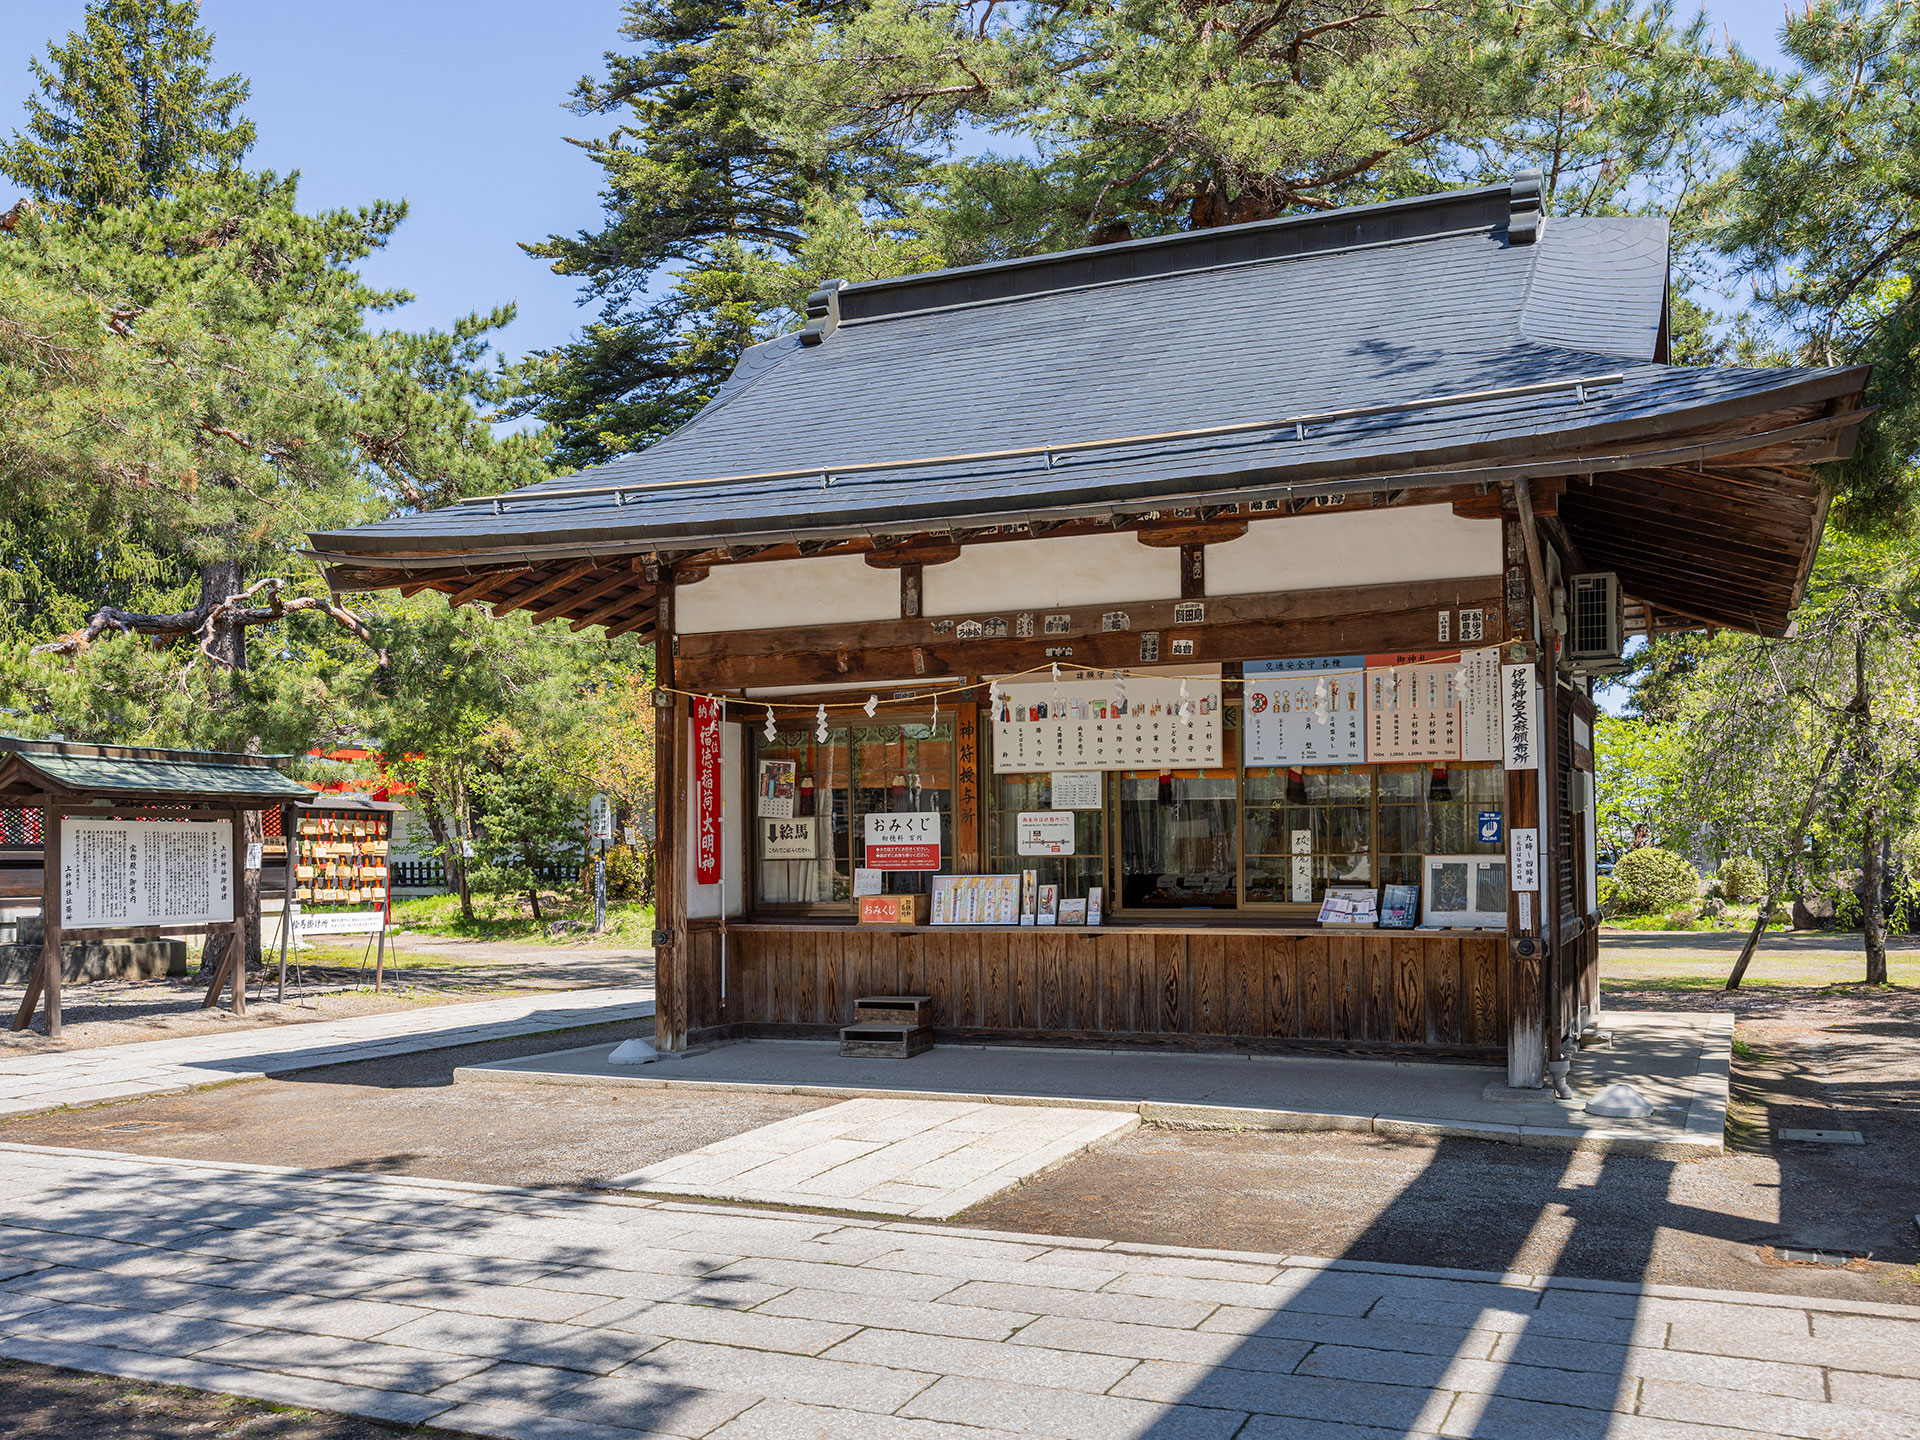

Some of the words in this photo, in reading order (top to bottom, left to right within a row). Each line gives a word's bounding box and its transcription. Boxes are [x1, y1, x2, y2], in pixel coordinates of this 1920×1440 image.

[1265, 659, 1316, 671] 交通安全守
[1322, 658, 1341, 668] 各種
[1076, 670, 1104, 680] 諸願守
[1511, 668, 1530, 766] 伊勢神宮大麻頒布所
[959, 720, 976, 828] 神符授与所
[700, 725, 715, 874] 福徳稲荷大明神
[779, 823, 808, 840] 絵馬
[874, 817, 930, 832] おみくじ
[1294, 834, 1309, 877] 破魔矢
[864, 905, 896, 915] おみくじ
